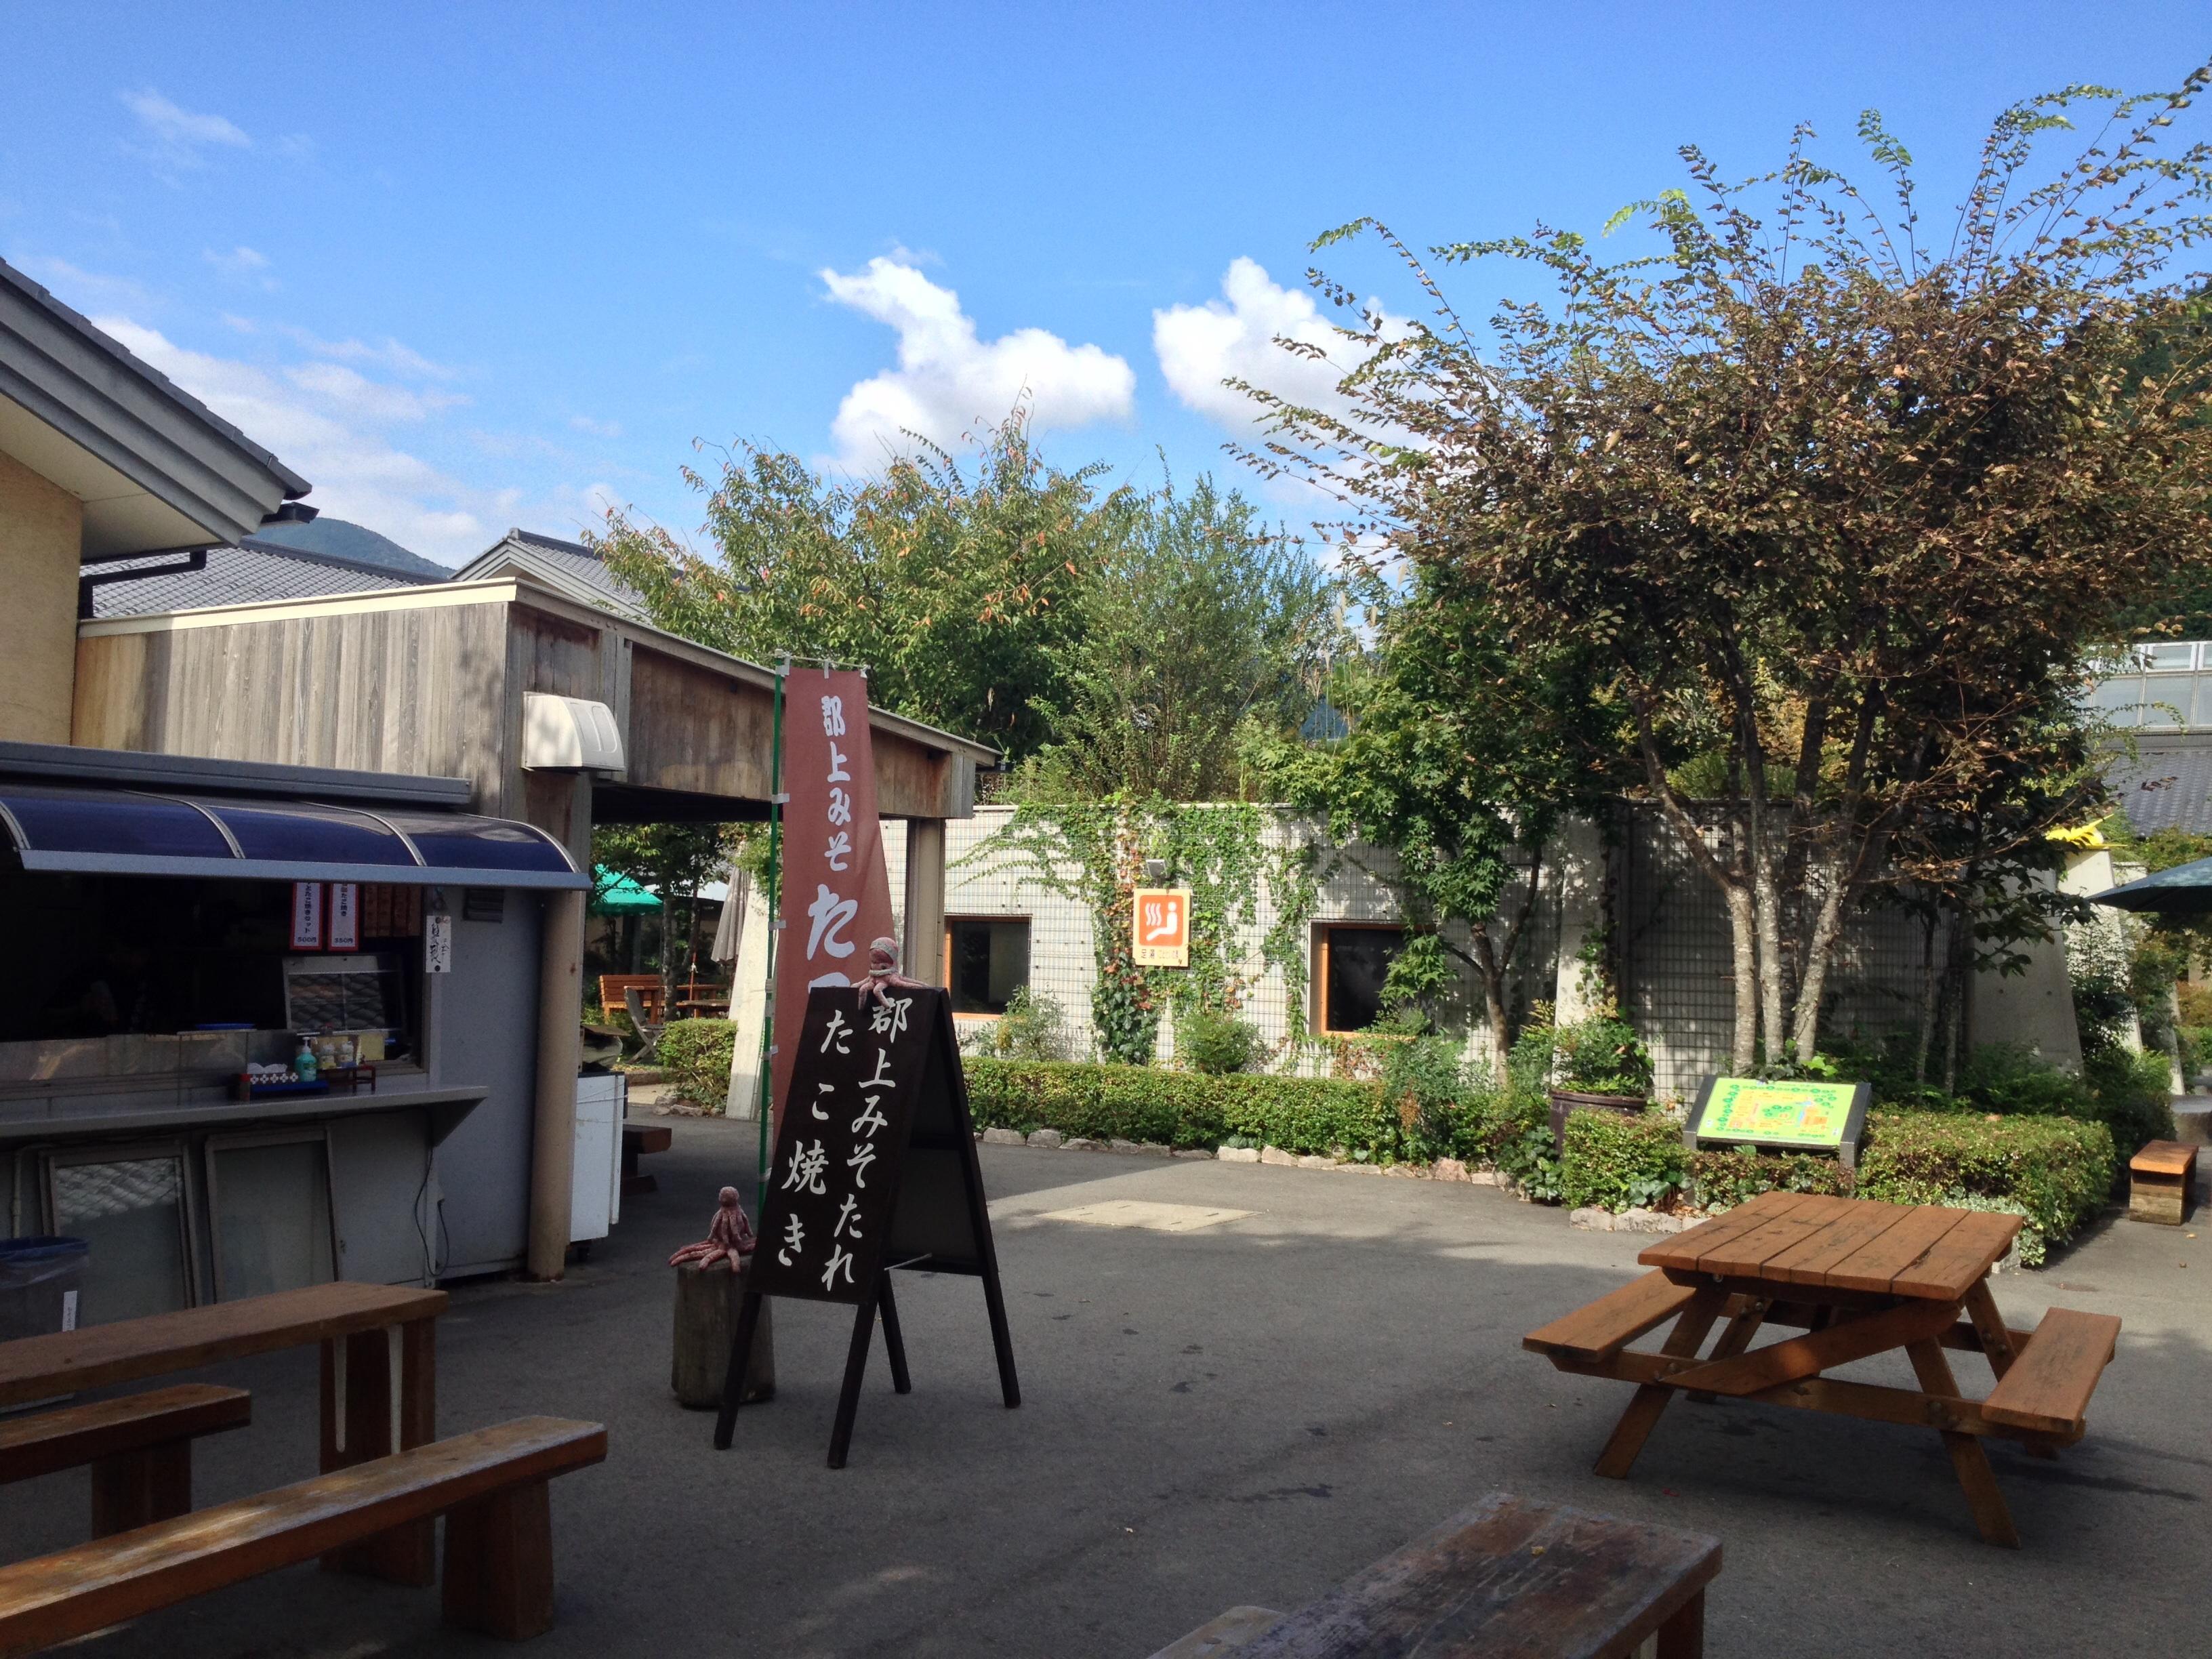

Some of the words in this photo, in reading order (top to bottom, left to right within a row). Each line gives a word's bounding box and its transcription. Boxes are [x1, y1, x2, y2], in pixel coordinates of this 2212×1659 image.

[806, 695, 858, 994] 郡上みそた
[779, 1009, 854, 1267] たこ焼き
[821, 997, 913, 1291] 郡上みそたれ
